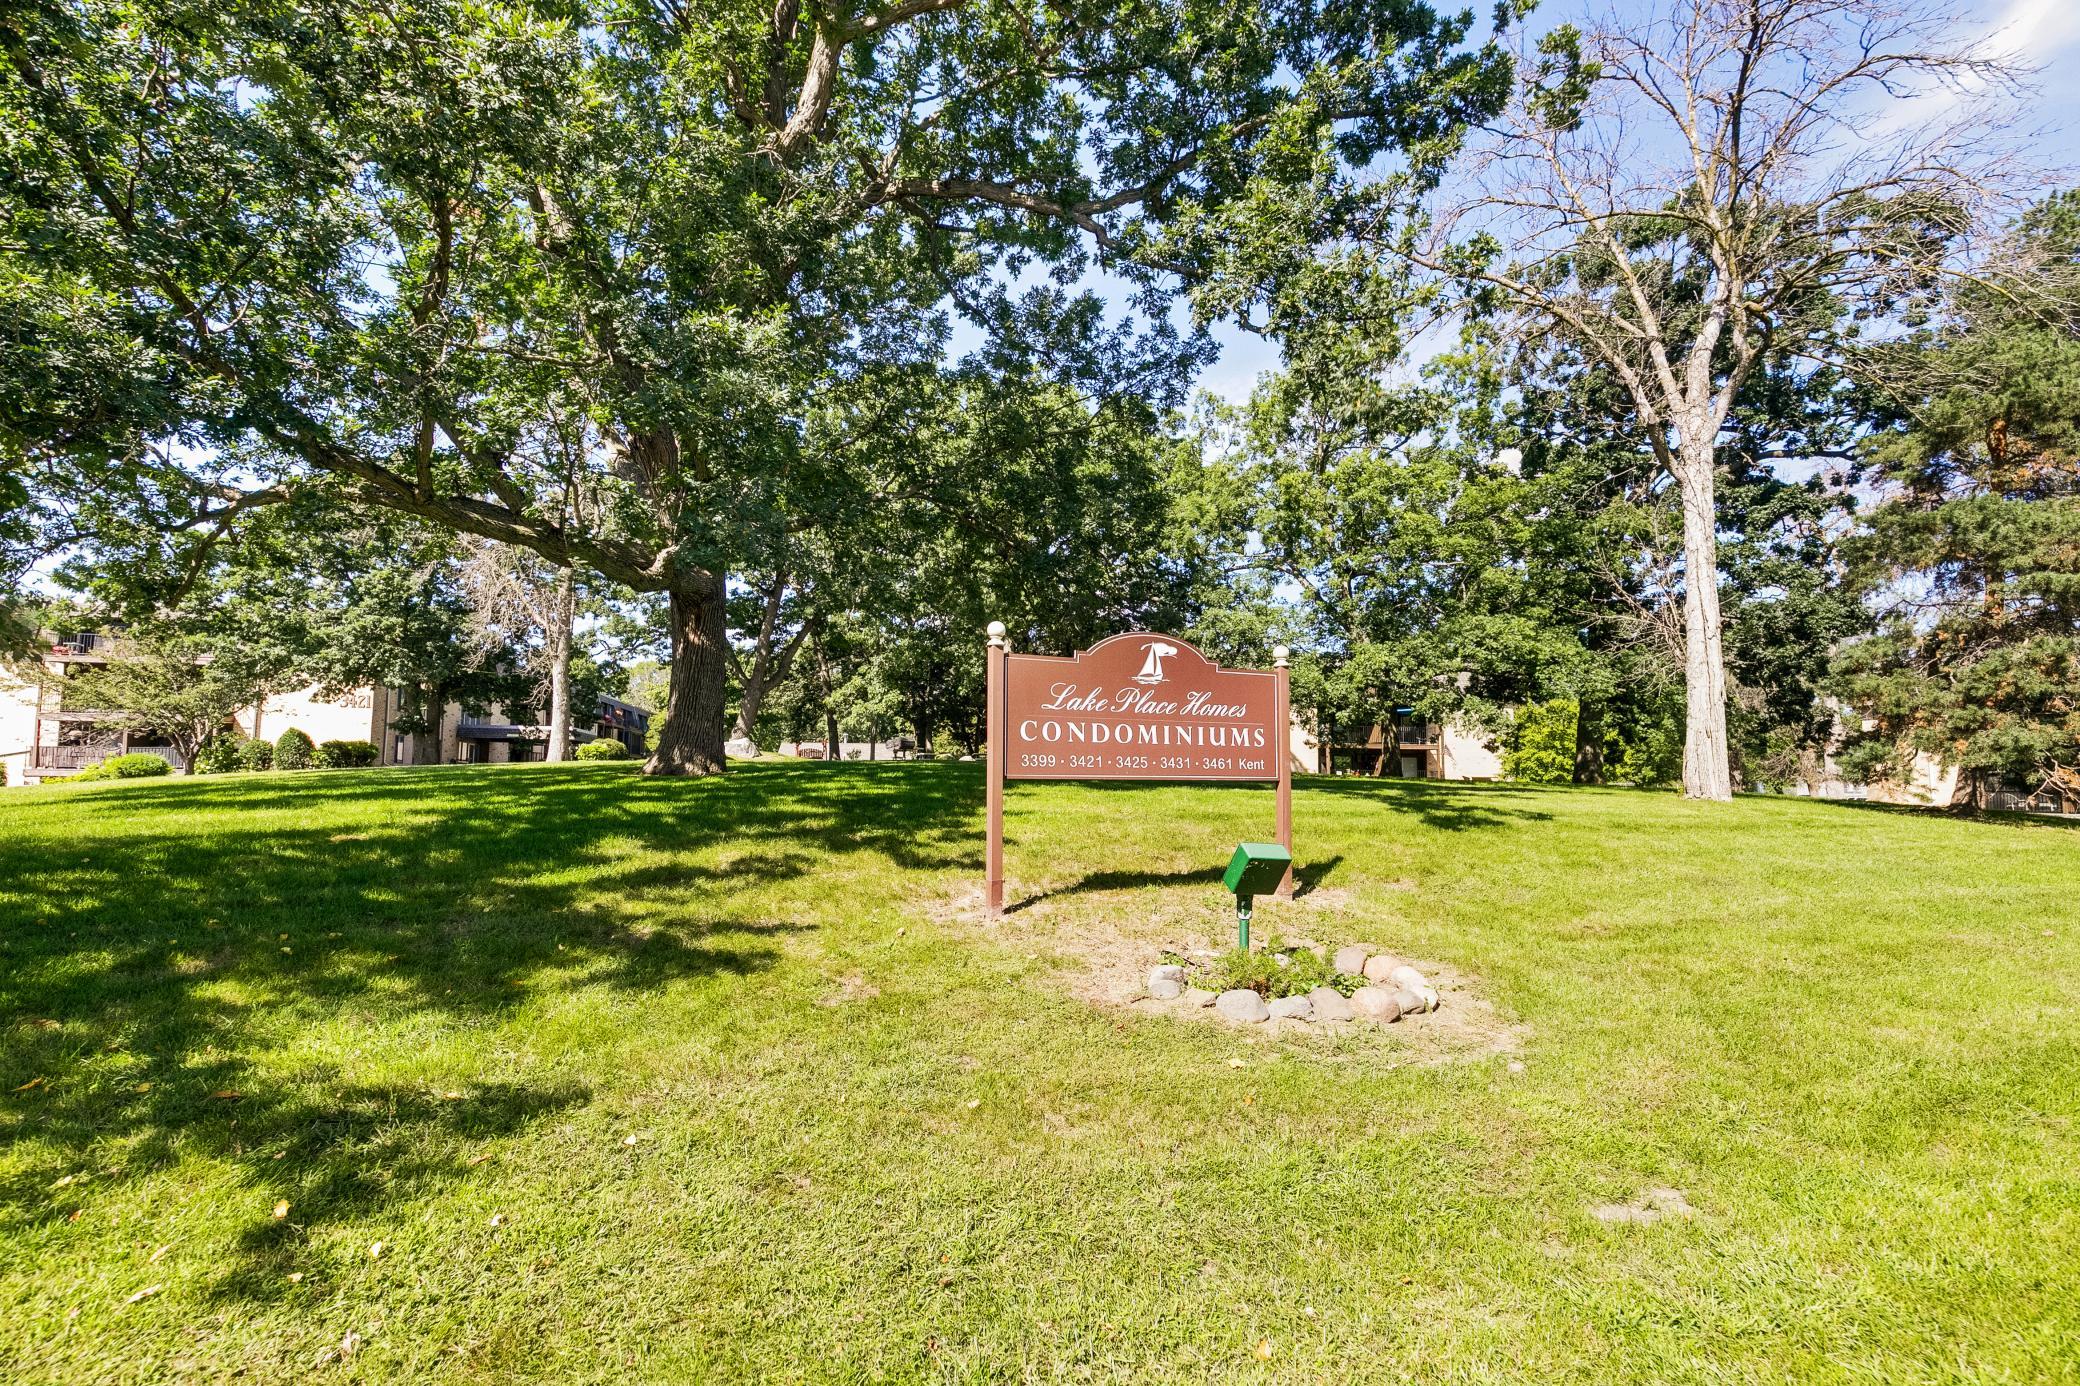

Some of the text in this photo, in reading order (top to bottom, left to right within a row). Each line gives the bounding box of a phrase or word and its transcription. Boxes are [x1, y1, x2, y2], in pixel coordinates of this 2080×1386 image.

[1041, 682, 1247, 718] Lake Place Homes
[1019, 720, 1266, 748] CONDOMINIUMS
[1021, 754, 1265, 770] 3399 3421 3425 3431 3461 Kent
